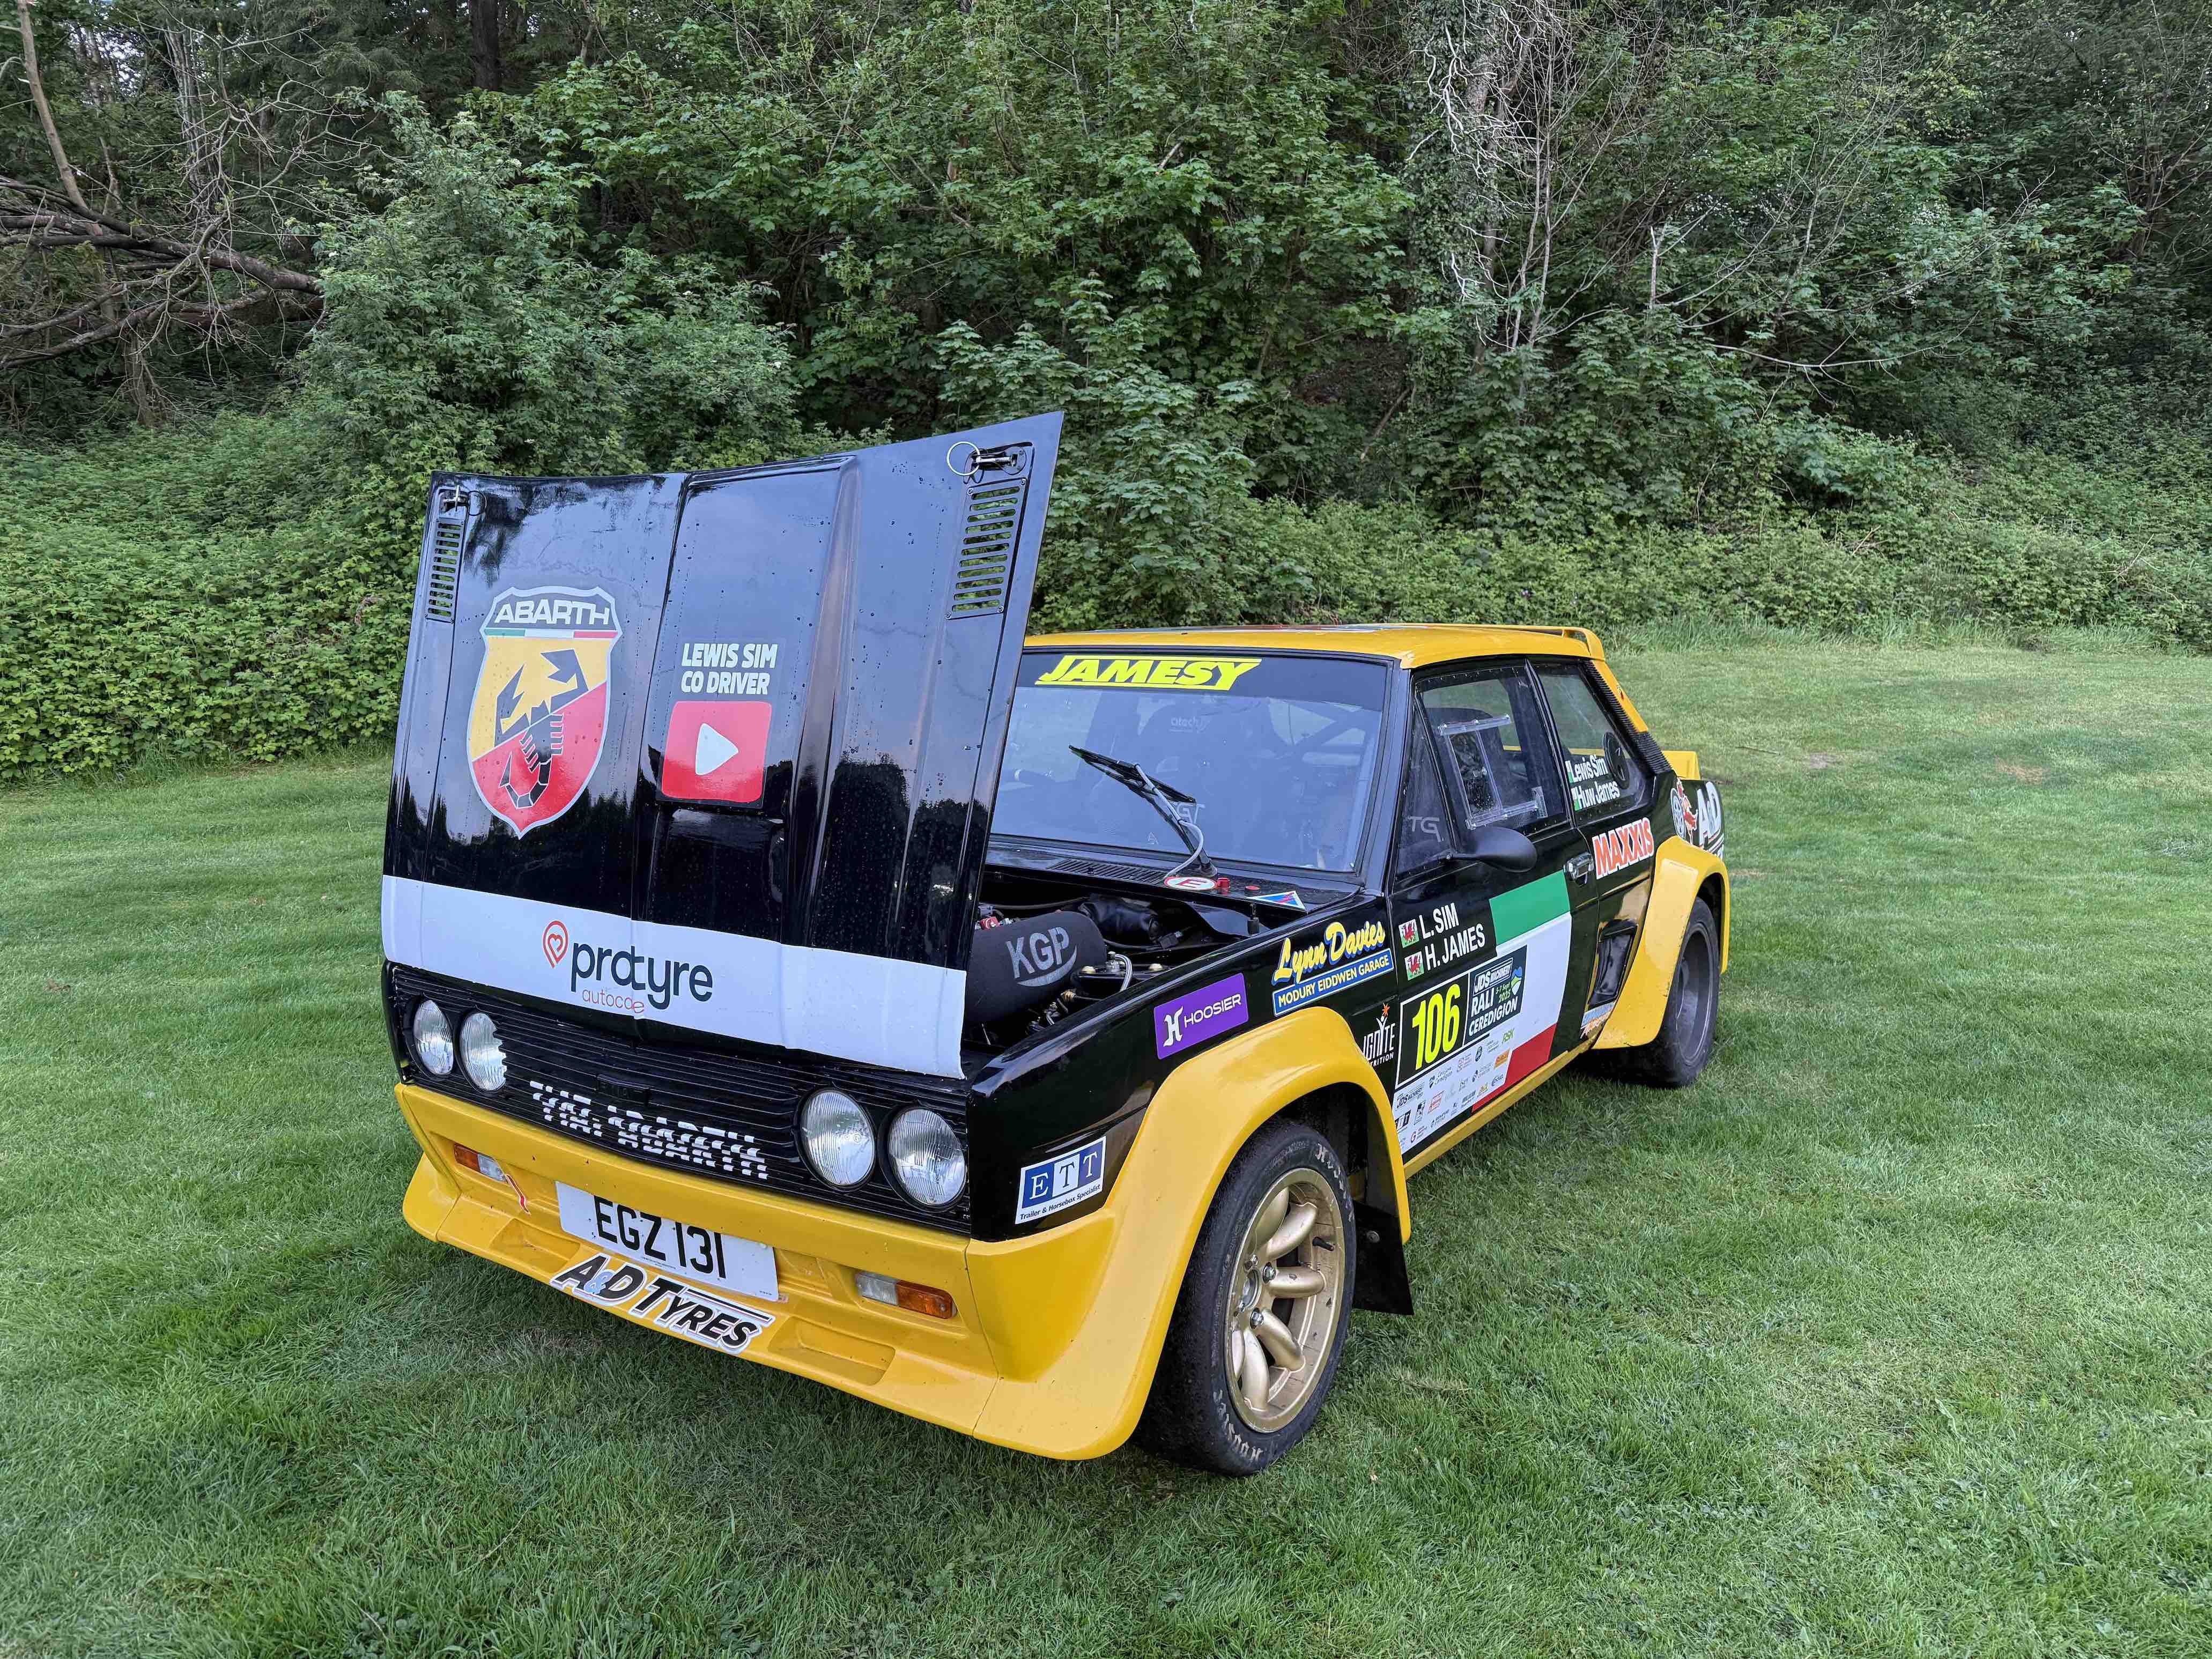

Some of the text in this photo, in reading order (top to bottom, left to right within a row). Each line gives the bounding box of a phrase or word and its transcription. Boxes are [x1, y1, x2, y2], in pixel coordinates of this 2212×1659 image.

[494, 599, 610, 625] ABARTH
[682, 643, 778, 668] LEWIS SIM
[1034, 655, 1262, 691] JAMESY
[681, 670, 770, 695] CO DRIVER
[1567, 754, 1609, 783] Lewis Sim
[1575, 786, 1596, 810] Huw
[1594, 781, 1620, 804] James
[1592, 817, 1654, 880] MAXXIS
[1005, 927, 1069, 979] KGP
[1271, 921, 1385, 986] Lynn Davies
[571, 942, 713, 1010] protyre
[1278, 955, 1390, 1008] MODURY EIDDWEN GARAGE
[1475, 971, 1491, 994] JDS
[1184, 993, 1242, 1028] HOOSIER
[1471, 987, 1495, 1017] RALI
[1499, 990, 1511, 1003] 2025
[1412, 983, 1461, 1070] 106
[1469, 996, 1518, 1036] CEREDIGION
[1370, 1052, 1394, 1067] TRITION
[1020, 1210, 1041, 1220] Trailer
[1048, 1197, 1076, 1212] Horsebox
[1076, 1184, 1100, 1201] Specialist
[593, 1195, 726, 1279] EGZ 131
[633, 1276, 763, 1349] TYRES
